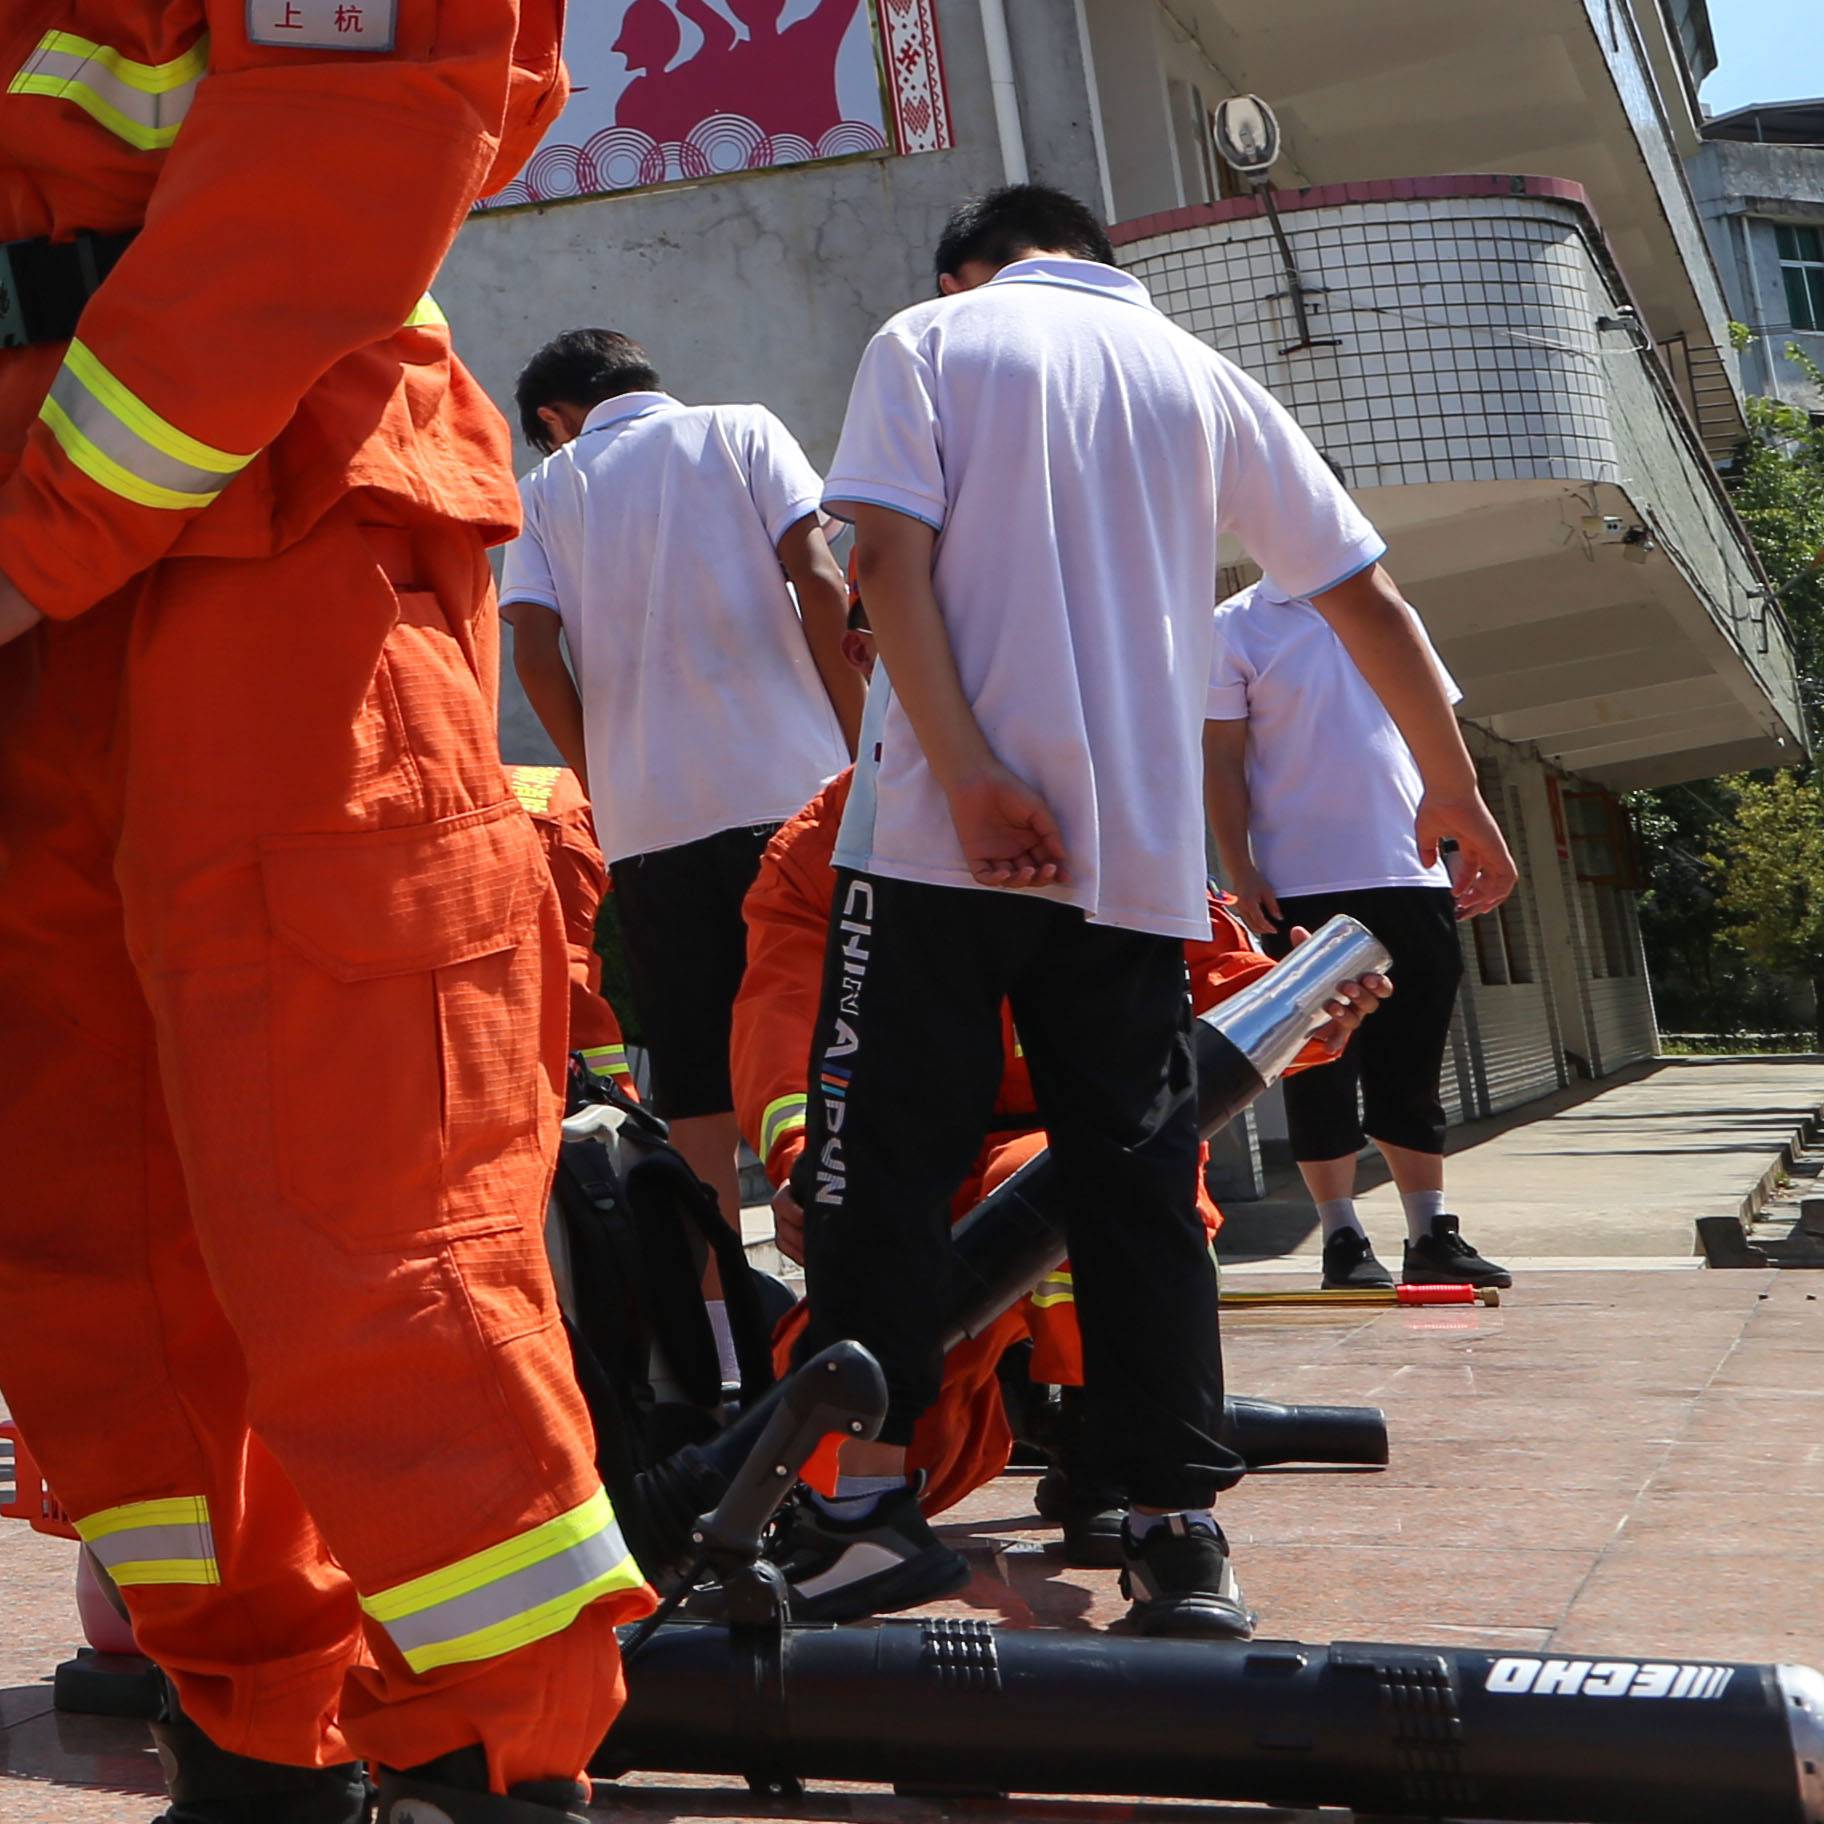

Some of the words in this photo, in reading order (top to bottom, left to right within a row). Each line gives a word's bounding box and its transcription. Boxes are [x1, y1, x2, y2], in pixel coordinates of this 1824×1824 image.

[274, 1, 364, 34] 上杭
[823, 879, 874, 1059] CHINA
[1485, 1656, 1718, 1700] ECHO
